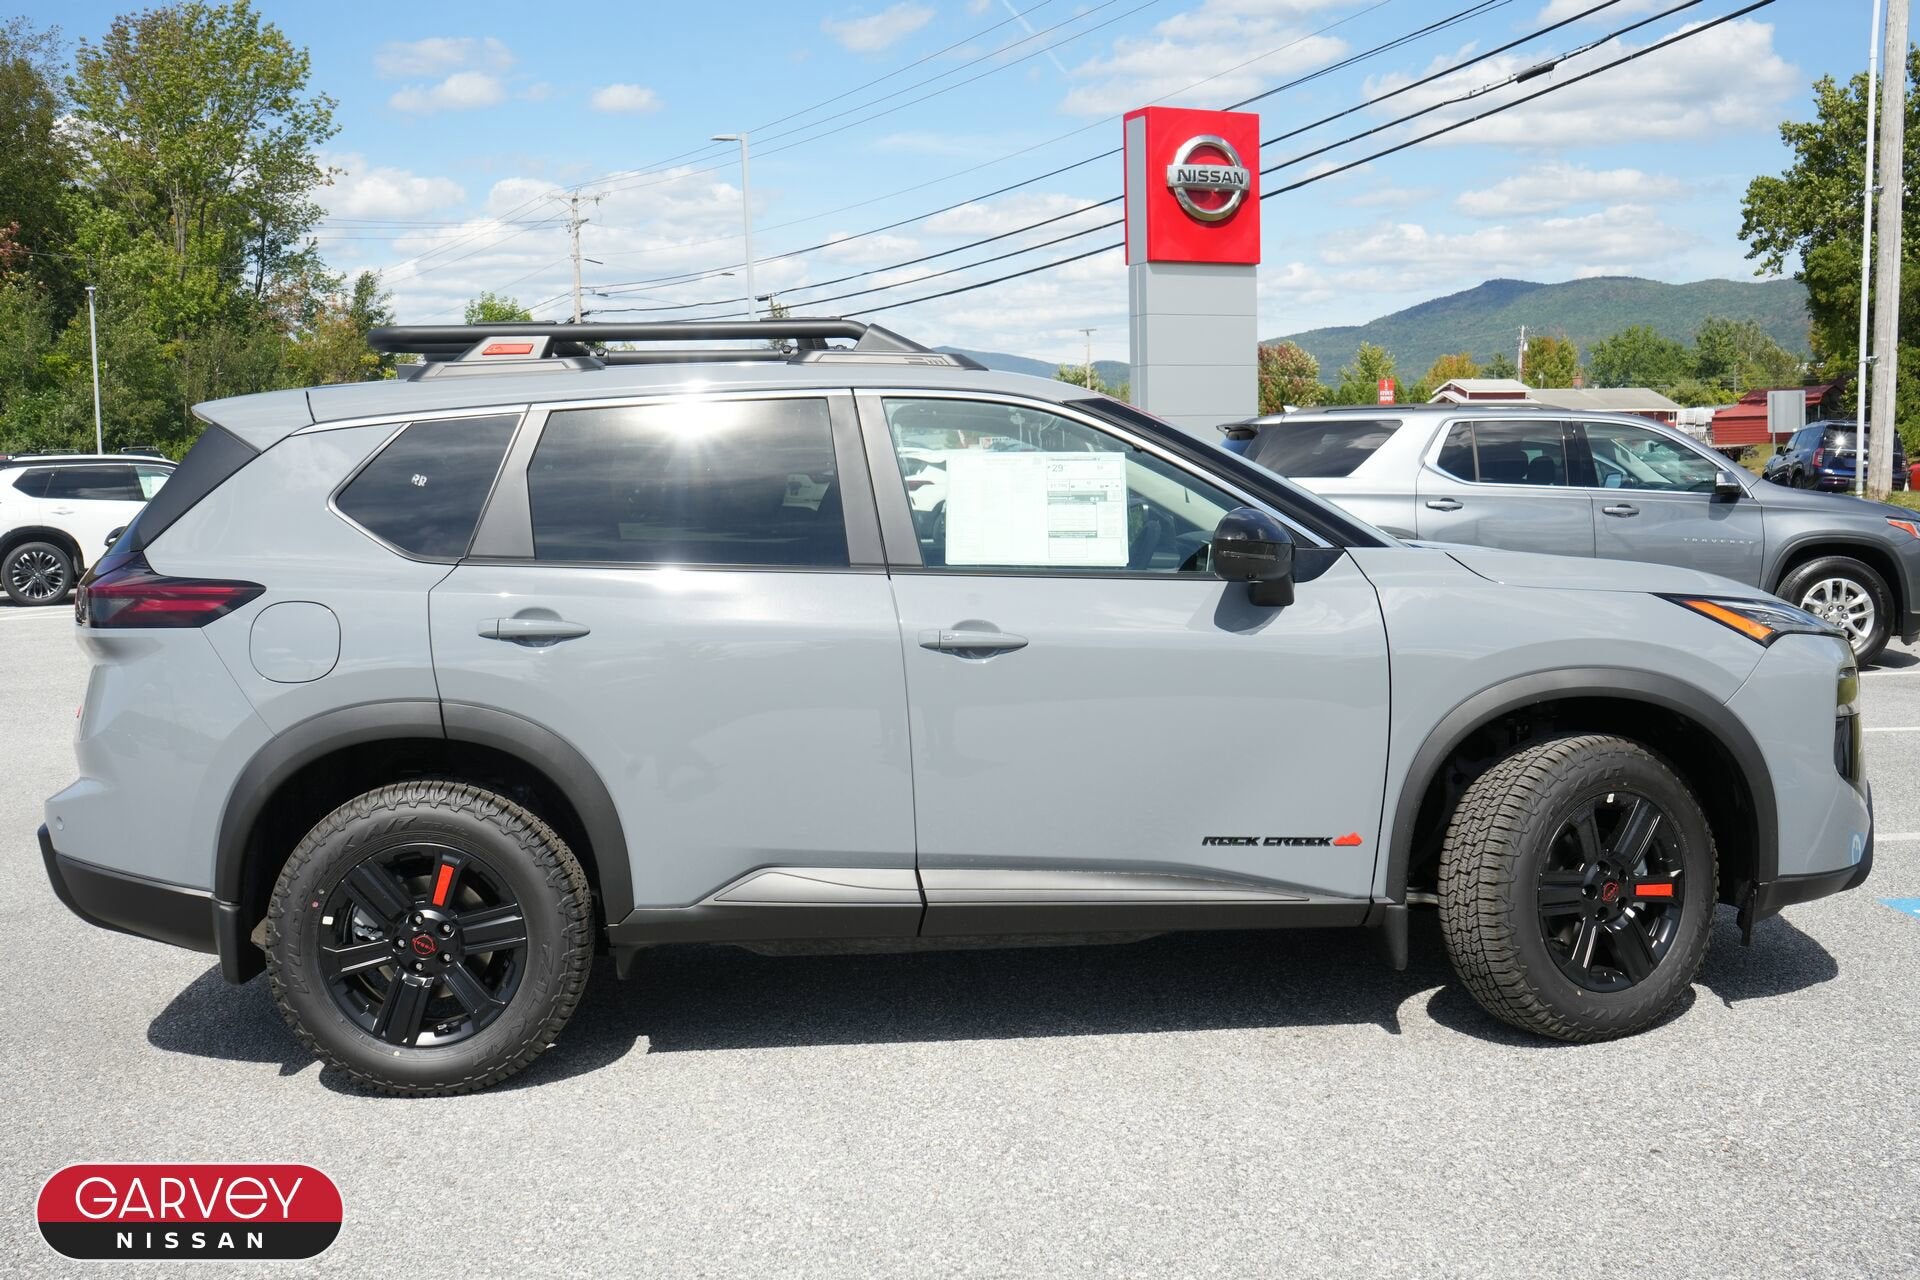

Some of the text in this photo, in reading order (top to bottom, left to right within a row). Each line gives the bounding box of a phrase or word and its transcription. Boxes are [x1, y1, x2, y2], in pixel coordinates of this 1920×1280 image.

[1177, 168, 1244, 185] NISSAN
[1201, 836, 1333, 847] ROCK CREEK
